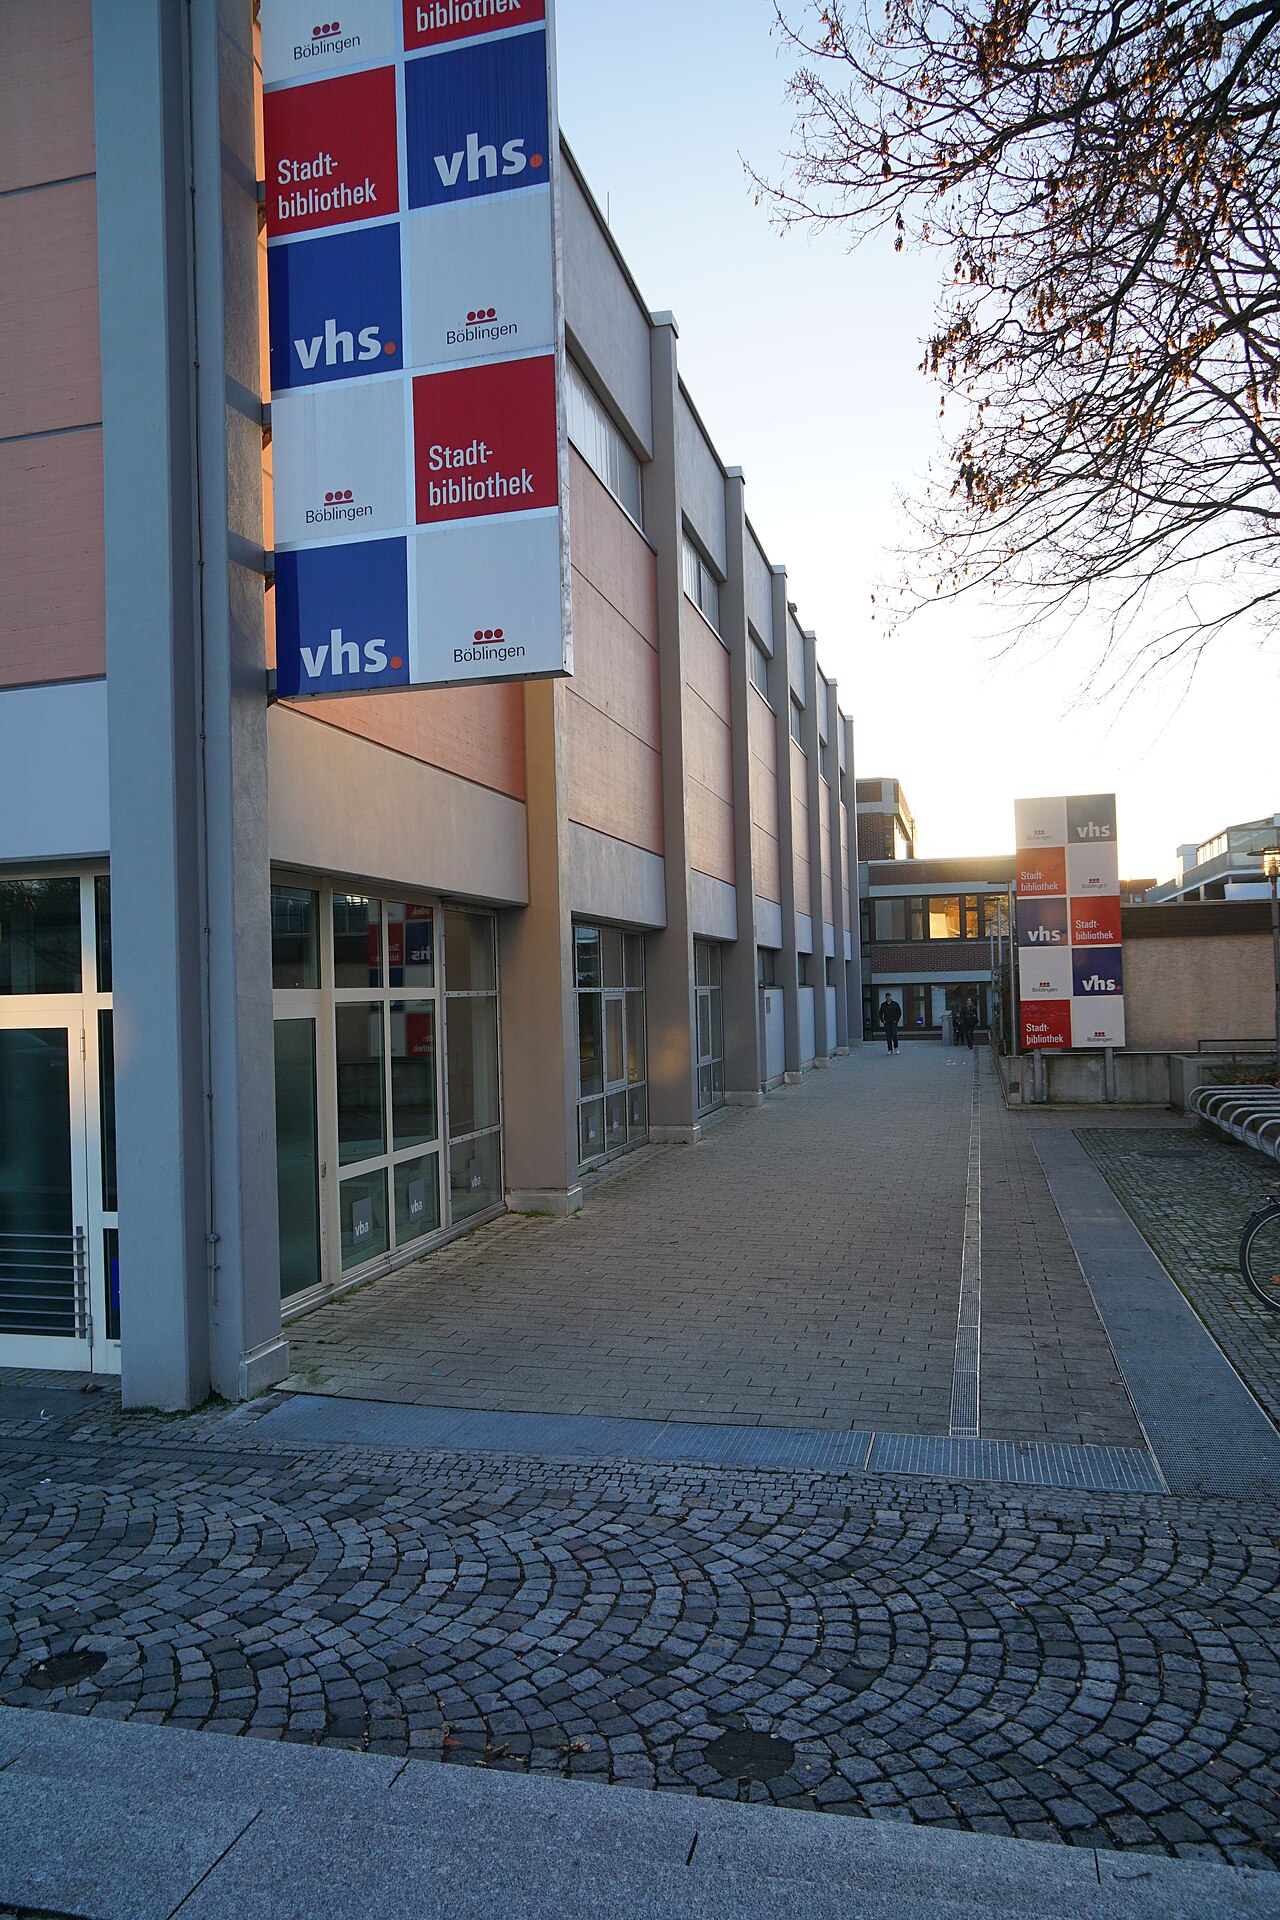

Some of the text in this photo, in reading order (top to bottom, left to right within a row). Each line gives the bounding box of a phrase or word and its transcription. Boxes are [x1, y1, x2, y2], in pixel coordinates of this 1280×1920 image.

[293, 34, 361, 60] Böblingen
[277, 152, 339, 186] Stadt-
[278, 177, 378, 220] bibliothek
[446, 322, 518, 345] Böblingen
[429, 439, 494, 471] Stadt-
[429, 468, 535, 507] bibliothek
[305, 504, 373, 524] Böblingen
[453, 645, 526, 663] Böblingen
[1021, 870, 1044, 880] Stadt-
[1021, 881, 1059, 892] bibliothek
[1075, 919, 1100, 929] Stadt-
[1075, 930, 1114, 940] bibliothek
[1026, 1022, 1050, 1032] Stadt-
[1026, 1034, 1064, 1044] bibliothek
